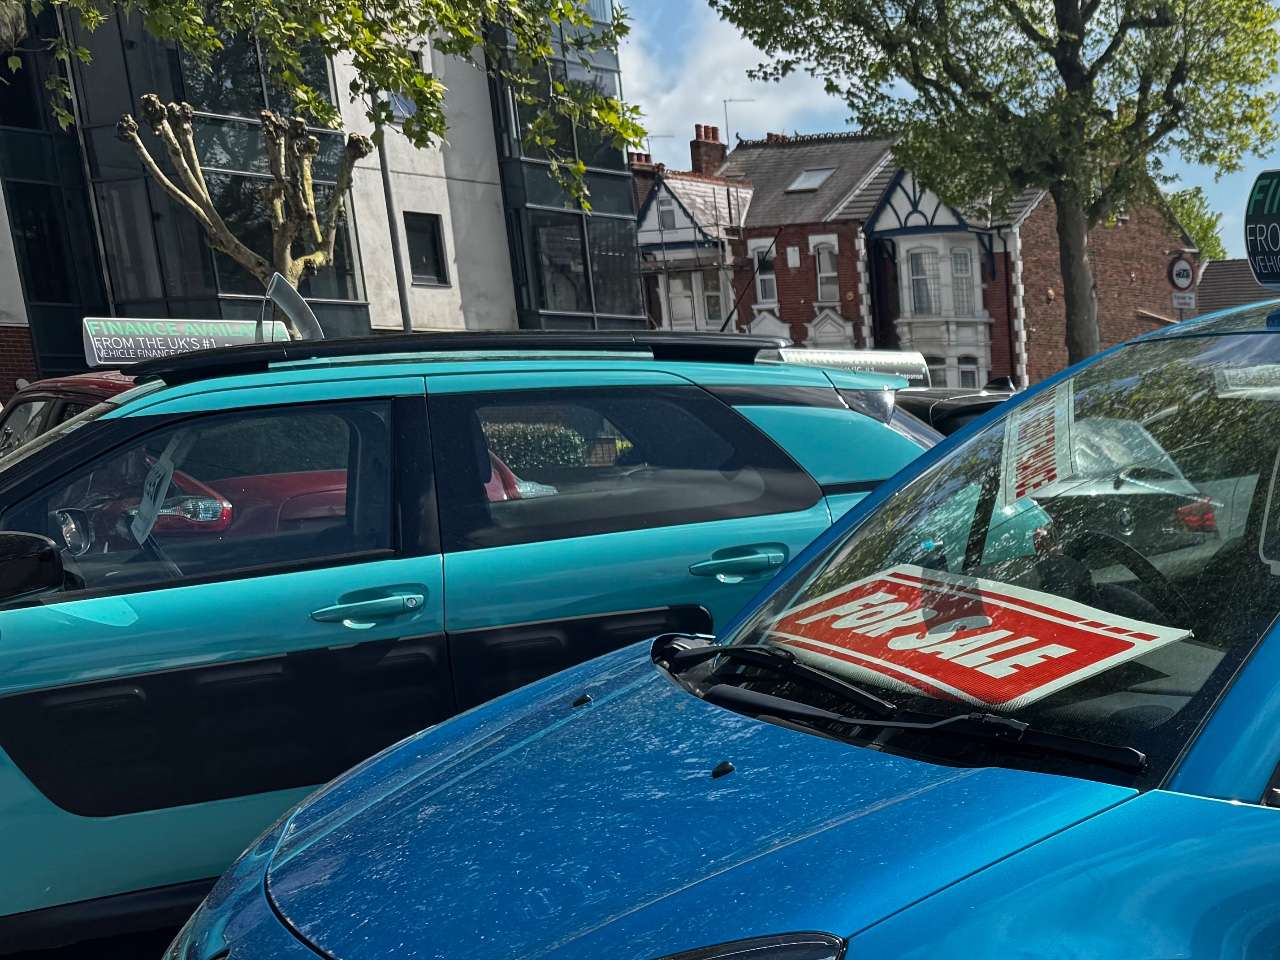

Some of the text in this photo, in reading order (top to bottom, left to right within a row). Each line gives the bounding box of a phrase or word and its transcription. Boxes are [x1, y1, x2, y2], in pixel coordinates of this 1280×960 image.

[88, 321, 177, 336] FINANCE
[94, 337, 216, 349] FROM THE UK'S #1
[97, 350, 136, 358] VEHICLE
[795, 592, 1078, 679] FOR SALE
